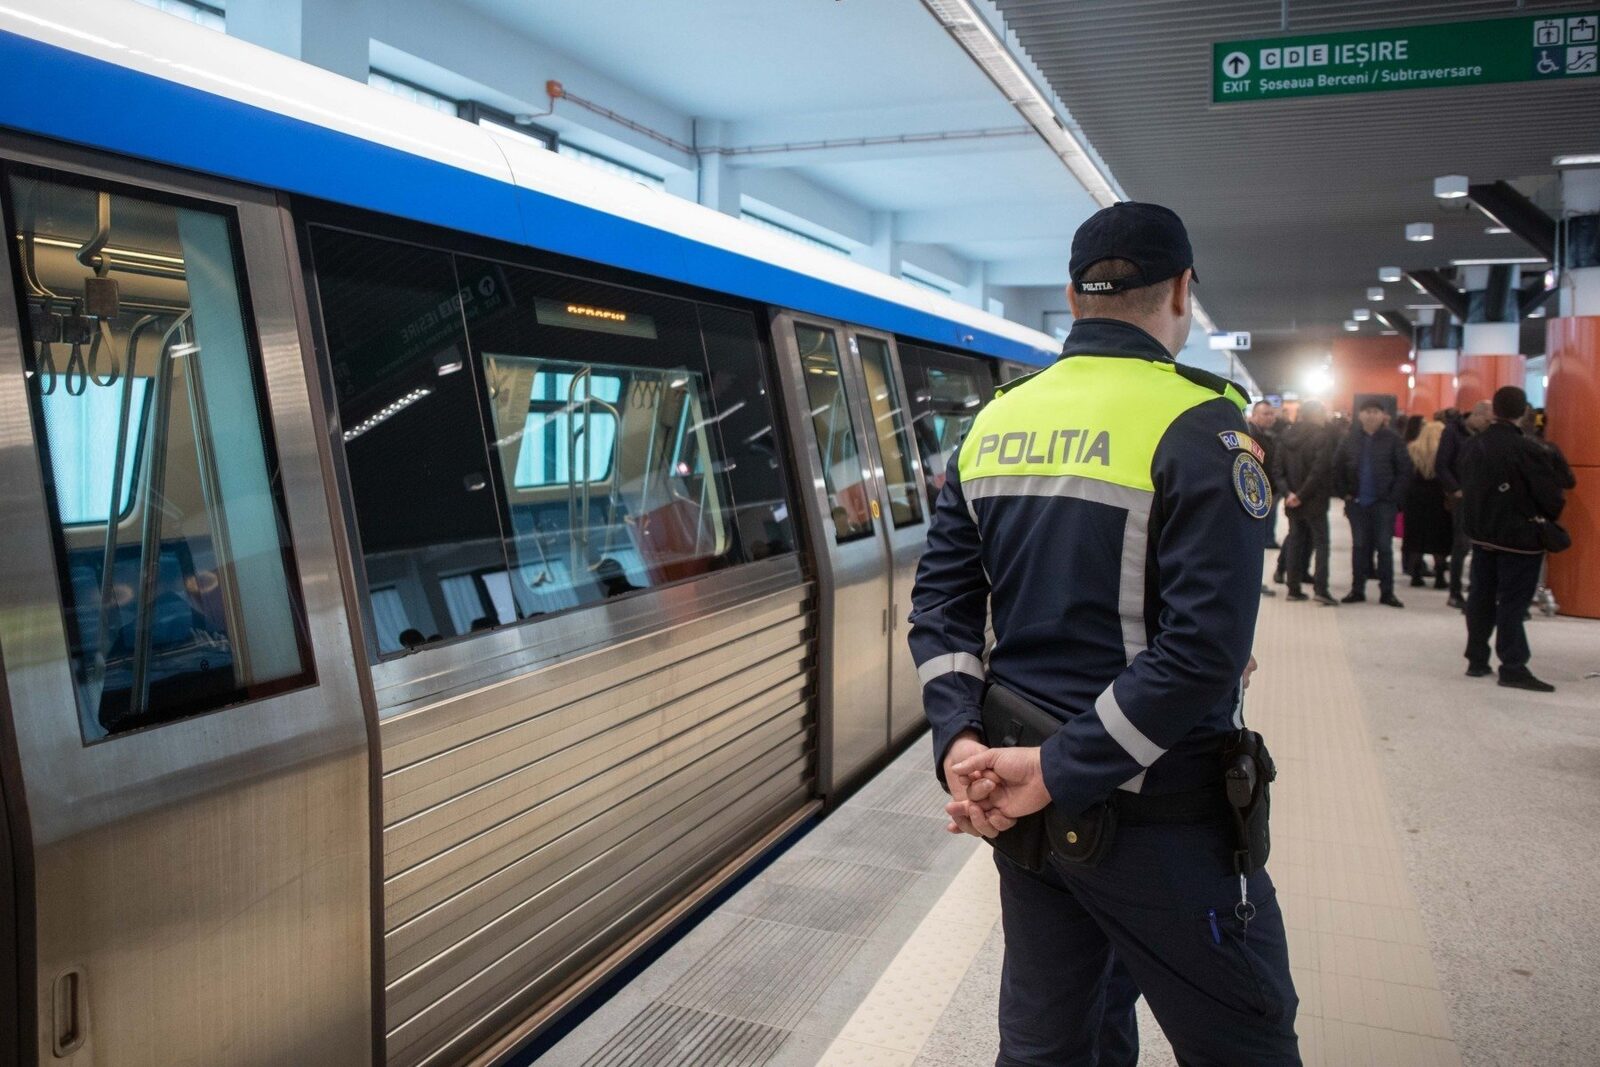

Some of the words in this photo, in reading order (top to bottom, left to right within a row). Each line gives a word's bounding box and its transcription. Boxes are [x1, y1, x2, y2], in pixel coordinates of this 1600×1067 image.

[1265, 52, 1276, 65] C
[1289, 50, 1300, 64] D
[1312, 48, 1323, 62] E
[1334, 40, 1409, 68] IEȘIRE
[1222, 79, 1251, 94] EXIT
[1317, 71, 1369, 87] Berceni
[1371, 69, 1379, 84] /
[1381, 65, 1483, 83] Subtraversare
[975, 428, 1111, 467] POLITIA
